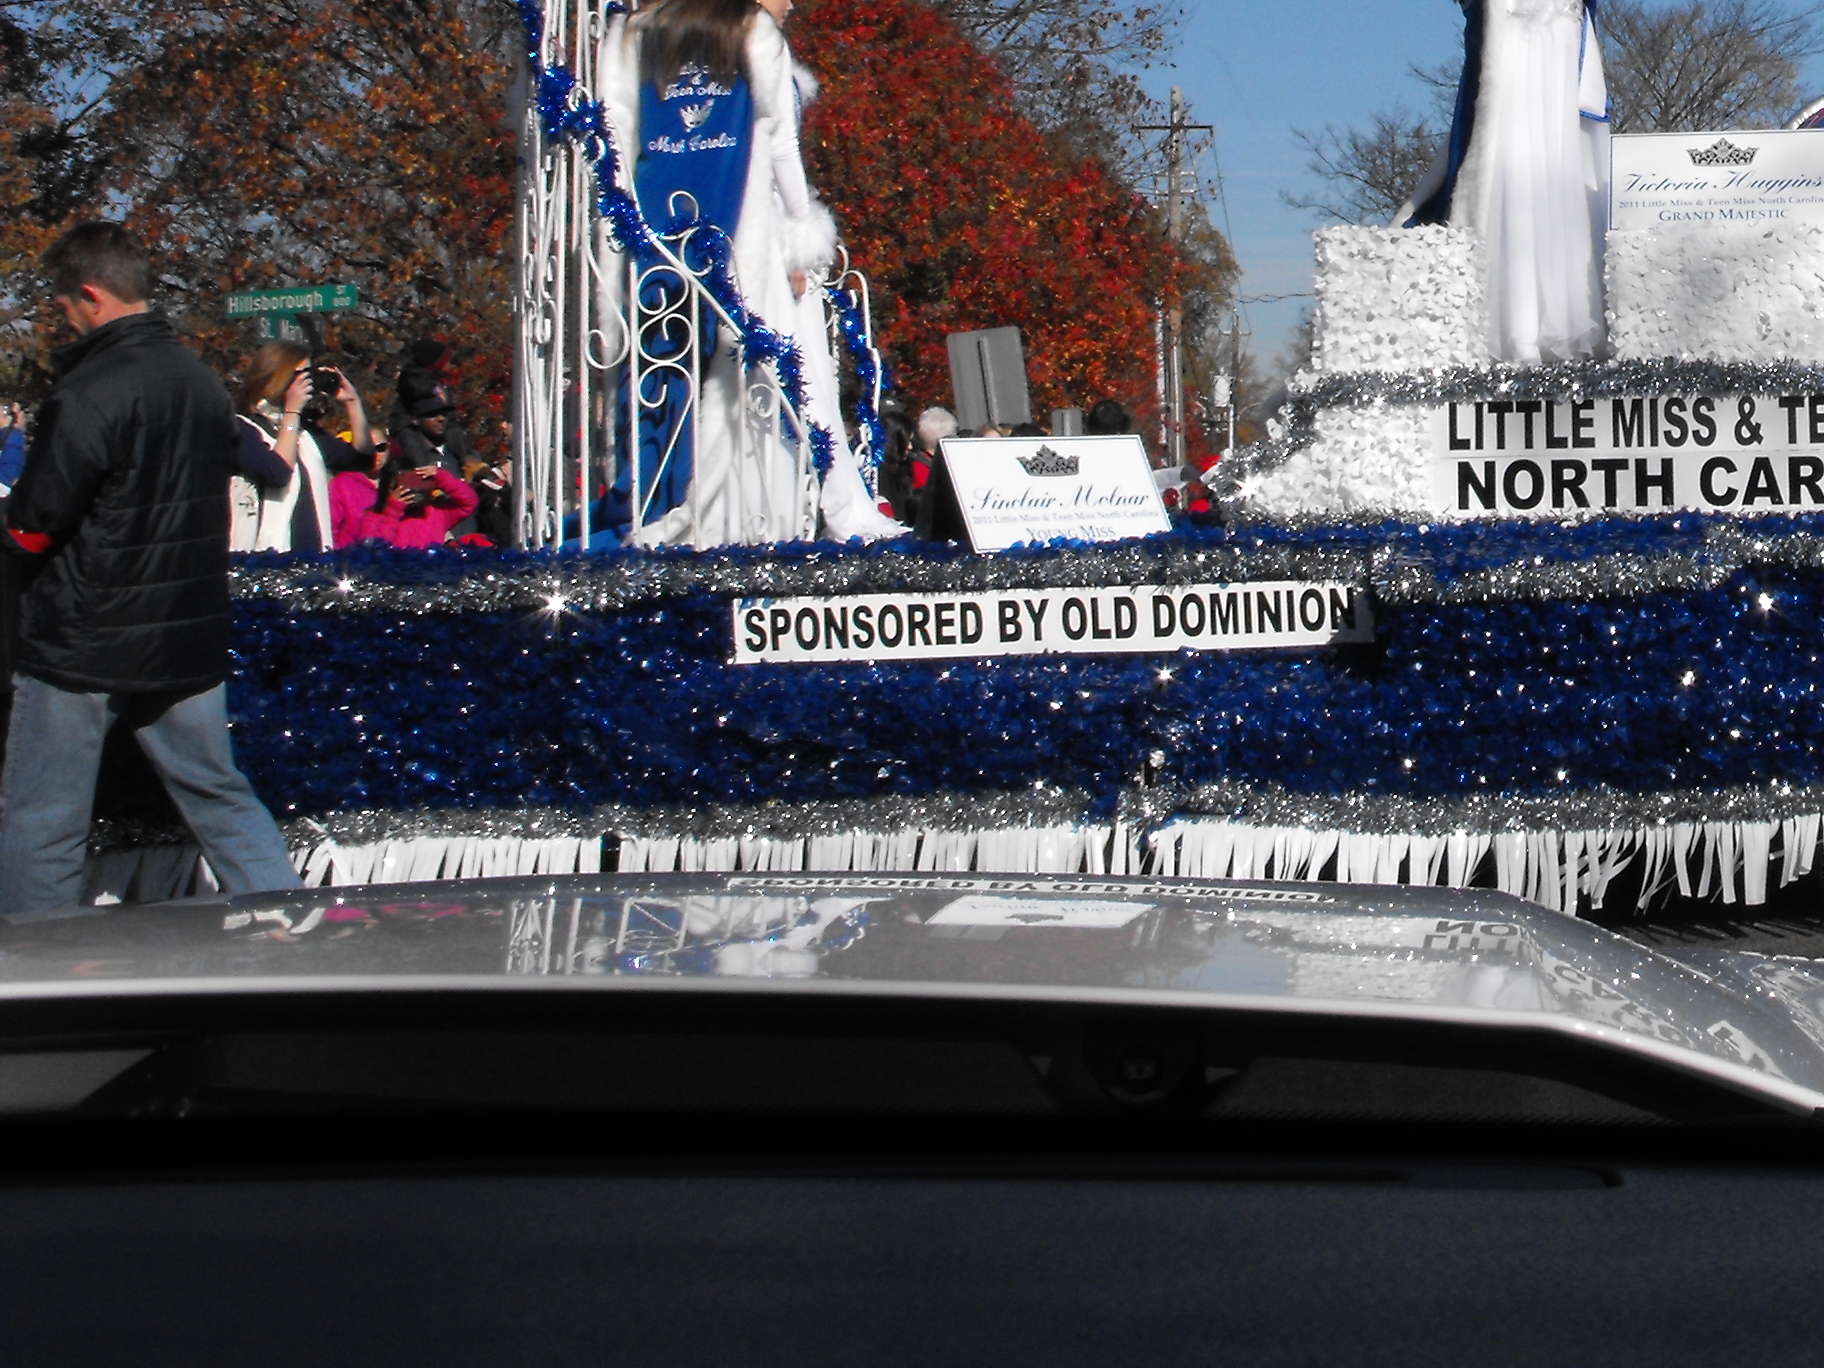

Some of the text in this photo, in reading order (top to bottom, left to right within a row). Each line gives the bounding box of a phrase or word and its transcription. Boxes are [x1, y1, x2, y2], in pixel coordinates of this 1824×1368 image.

[1623, 169, 1822, 195] Victoria Huggins
[1619, 201, 1639, 209] 2011
[1642, 199, 1667, 209] Little
[1670, 199, 1692, 207] Miss
[1707, 198, 1730, 206] Teen
[1733, 197, 1755, 206] Miss
[1758, 196, 1786, 205] North
[1659, 208, 1789, 222] GRAND MAJESTIC
[227, 292, 323, 314] Hillsborough
[1447, 399, 1595, 451] LITTLE
[1611, 396, 1717, 448] MISS
[1734, 396, 1764, 445] &
[1457, 458, 1675, 510] NORTH
[970, 484, 1149, 511] Sinclair Molnar
[996, 515, 1017, 524] Little
[1019, 514, 1040, 522] Miss
[1052, 513, 1073, 521] Teen
[1076, 512, 1096, 520] Miss
[1099, 511, 1121, 519] North
[1124, 510, 1159, 518] Carolina
[1080, 525, 1117, 538] MISS
[745, 587, 1357, 653] SPONSORED BY OLD DOMINION
